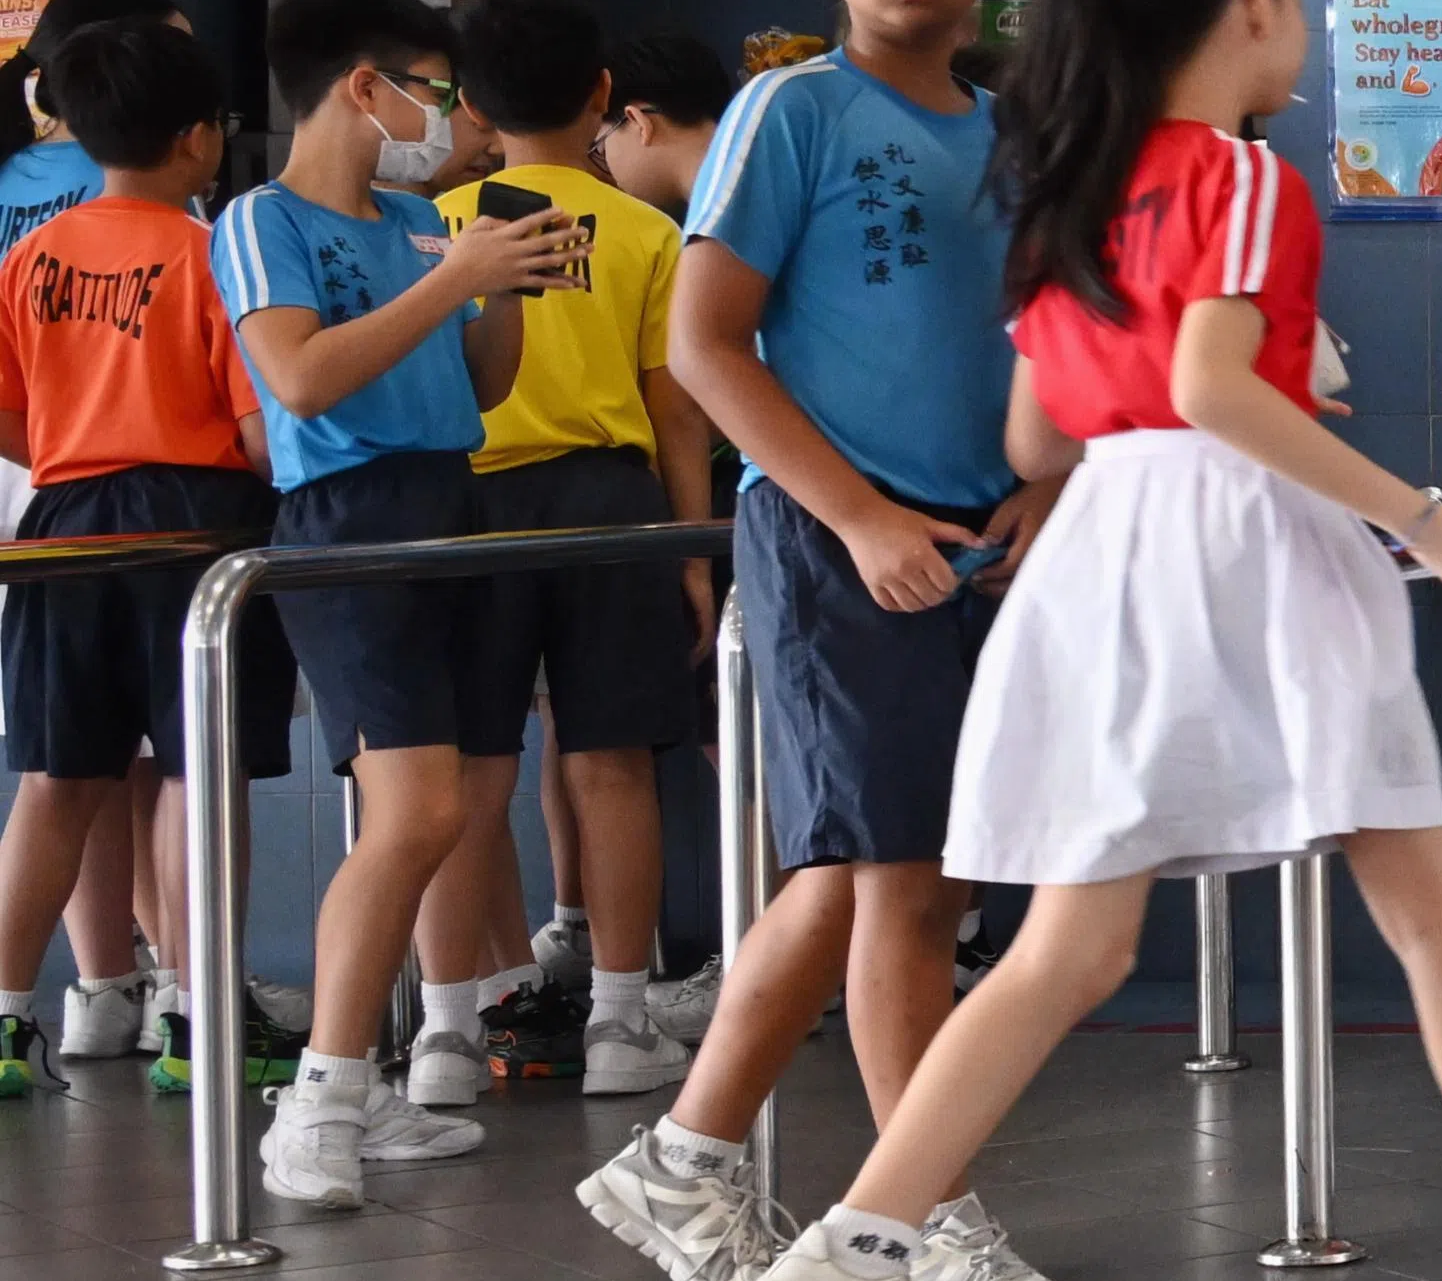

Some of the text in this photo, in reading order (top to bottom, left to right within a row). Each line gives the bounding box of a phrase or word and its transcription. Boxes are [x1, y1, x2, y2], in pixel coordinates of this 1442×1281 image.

[1355, 44, 1399, 68] Stay
[1355, 71, 1396, 89] and
[30, 251, 165, 340] GRATITUDE
